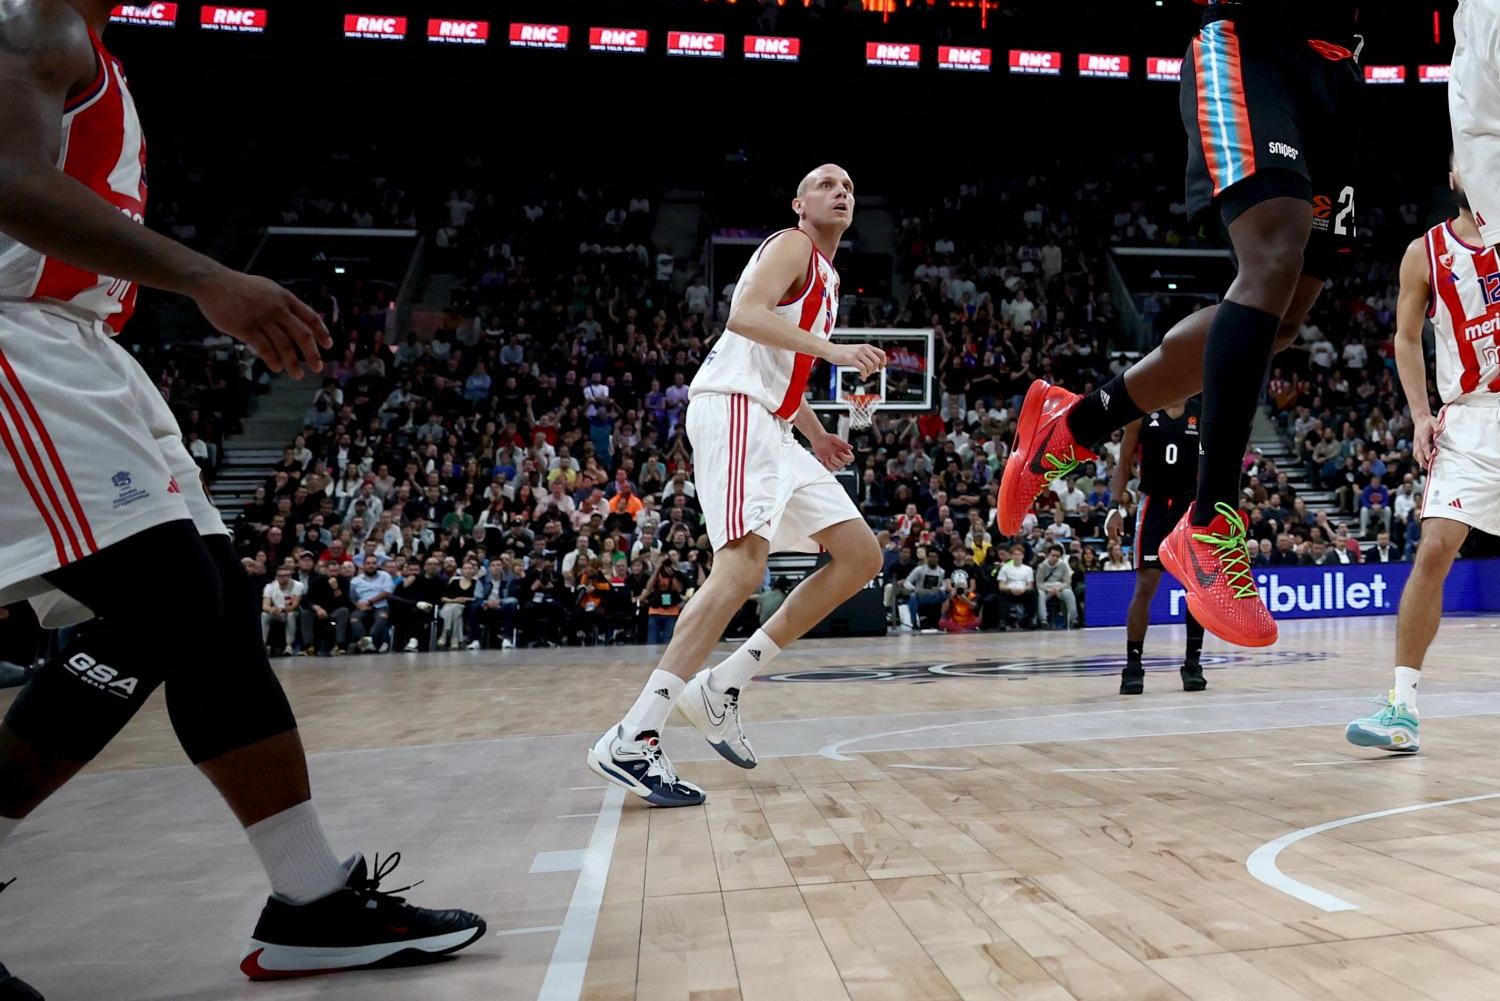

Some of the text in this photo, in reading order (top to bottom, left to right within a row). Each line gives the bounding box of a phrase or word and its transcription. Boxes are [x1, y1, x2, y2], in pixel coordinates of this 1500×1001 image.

[213, 8, 256, 26] RMC
[356, 16, 397, 33] RMC
[439, 20, 478, 37] RMC
[520, 25, 560, 42] RMC
[600, 29, 638, 46] RMC
[678, 34, 715, 50] RMC
[754, 37, 791, 54] RMC
[876, 44, 911, 60] RMC
[947, 47, 982, 64] RMC
[1018, 52, 1052, 68] RMC
[1088, 55, 1121, 71] RMC
[1268, 141, 1298, 160] snipes
[1334, 185, 1357, 238] 2
[1165, 443, 1178, 465] 0
[68, 652, 139, 696] GSA
